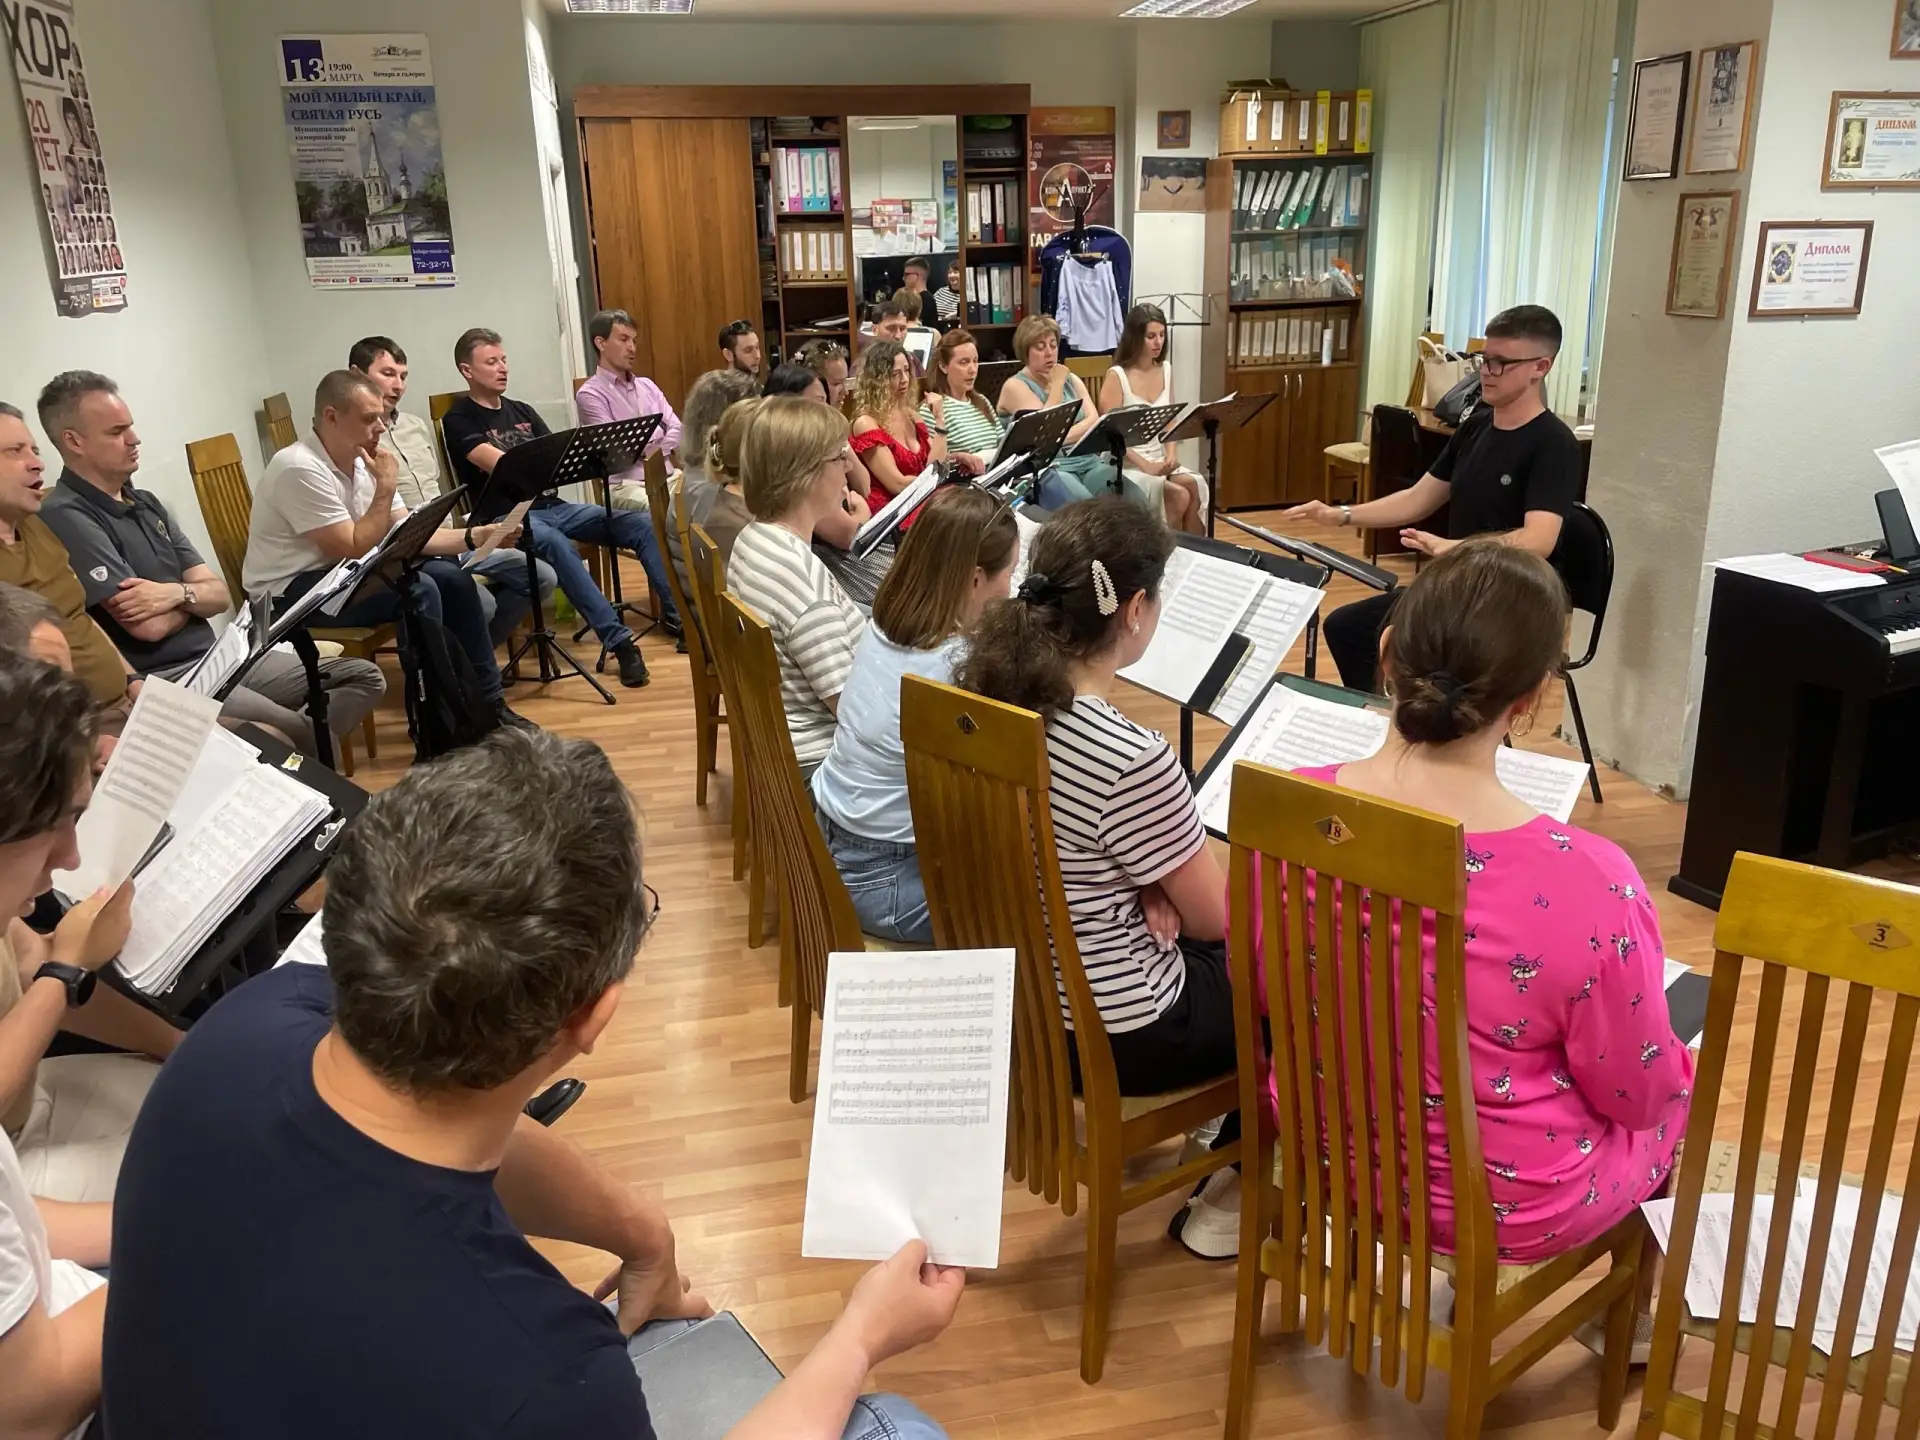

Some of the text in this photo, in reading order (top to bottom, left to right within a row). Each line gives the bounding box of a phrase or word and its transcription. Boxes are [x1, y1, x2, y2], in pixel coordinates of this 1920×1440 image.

[2, 1, 70, 80] ХОР
[290, 59, 326, 82] 13
[328, 63, 352, 71] 19:00
[330, 73, 364, 82] МАРТА
[289, 89, 427, 104] МОЙ МИЛЫЙ КРАЙ,
[26, 97, 51, 134] 20
[291, 109, 383, 121] СВЯТАЯ РУСЬ
[1804, 242, 1851, 257] Диплом
[416, 261, 450, 269] 72-32-71
[1327, 822, 1342, 838] 18
[1873, 928, 1886, 943] 3
